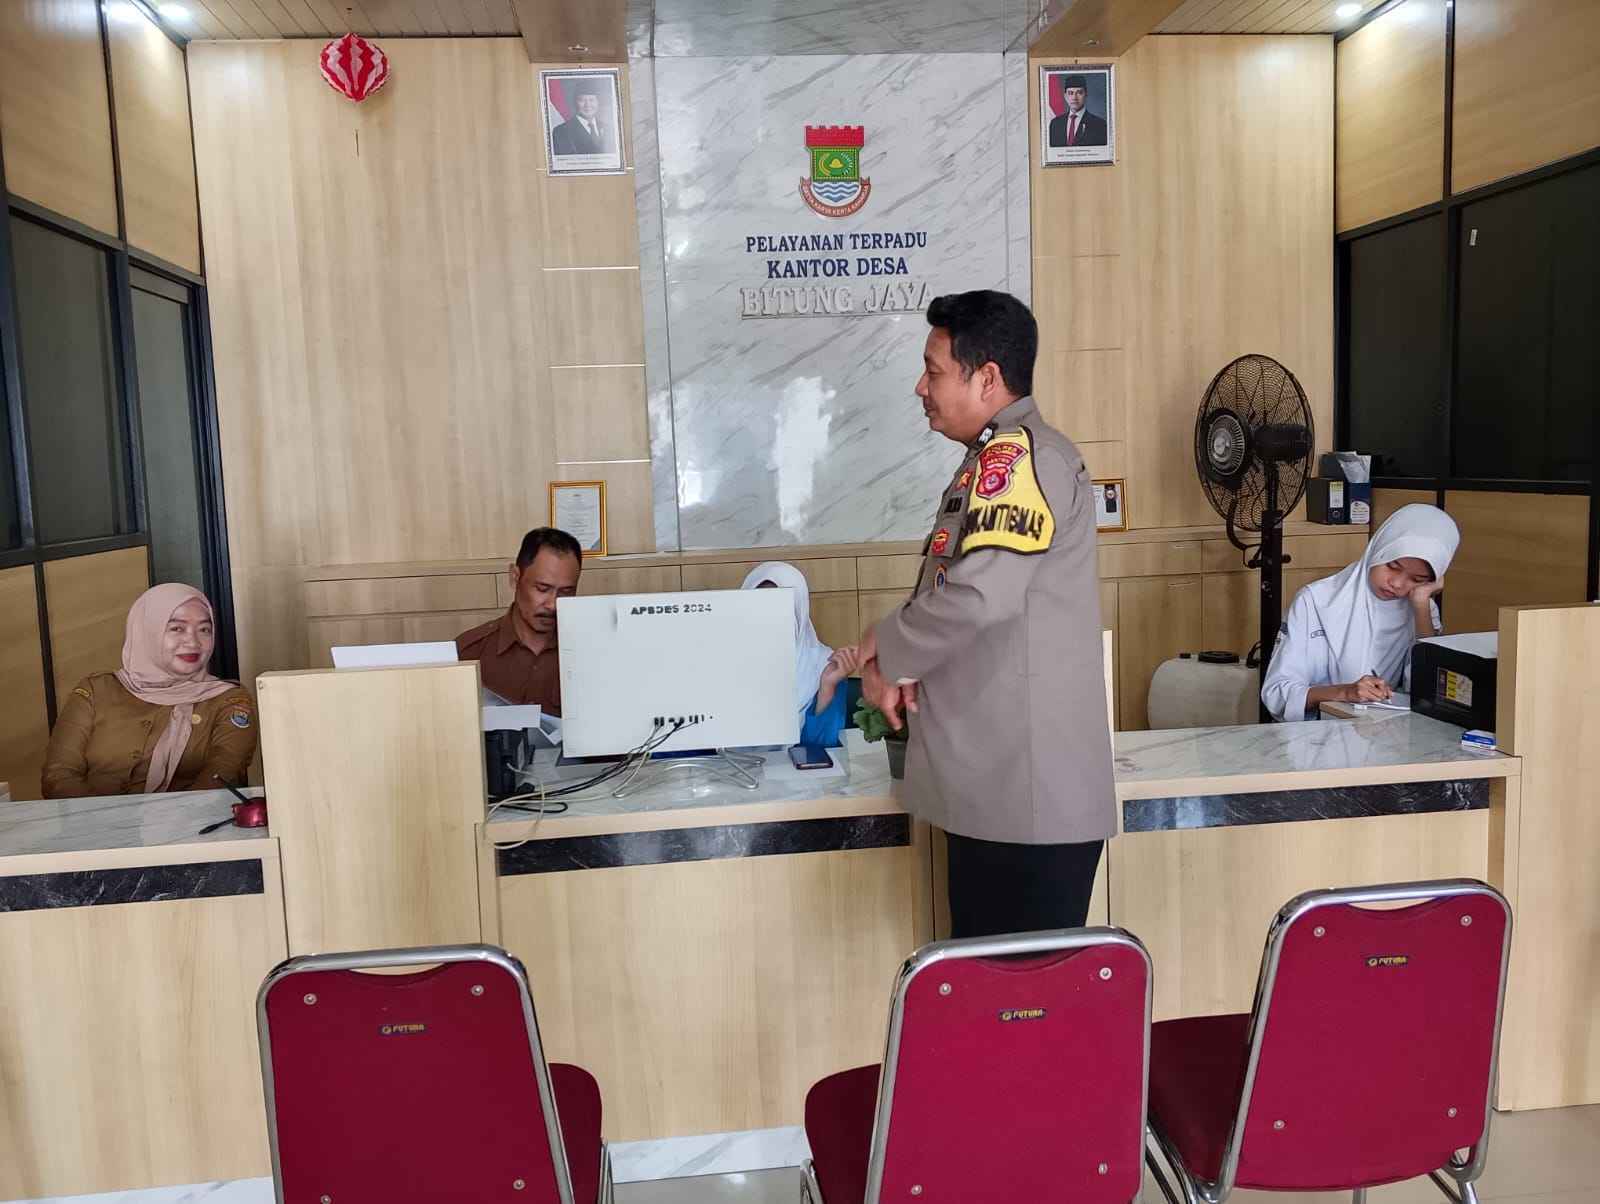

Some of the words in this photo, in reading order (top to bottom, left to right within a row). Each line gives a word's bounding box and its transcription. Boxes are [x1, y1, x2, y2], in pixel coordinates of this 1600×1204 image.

[746, 233, 844, 252] PELAYANAN
[850, 231, 928, 250] TERPADU
[767, 258, 850, 279] KANTOR
[856, 256, 909, 276] DESA
[740, 285, 853, 316] BITUNG
[864, 281, 934, 313] JAYA
[683, 603, 712, 613] 2024
